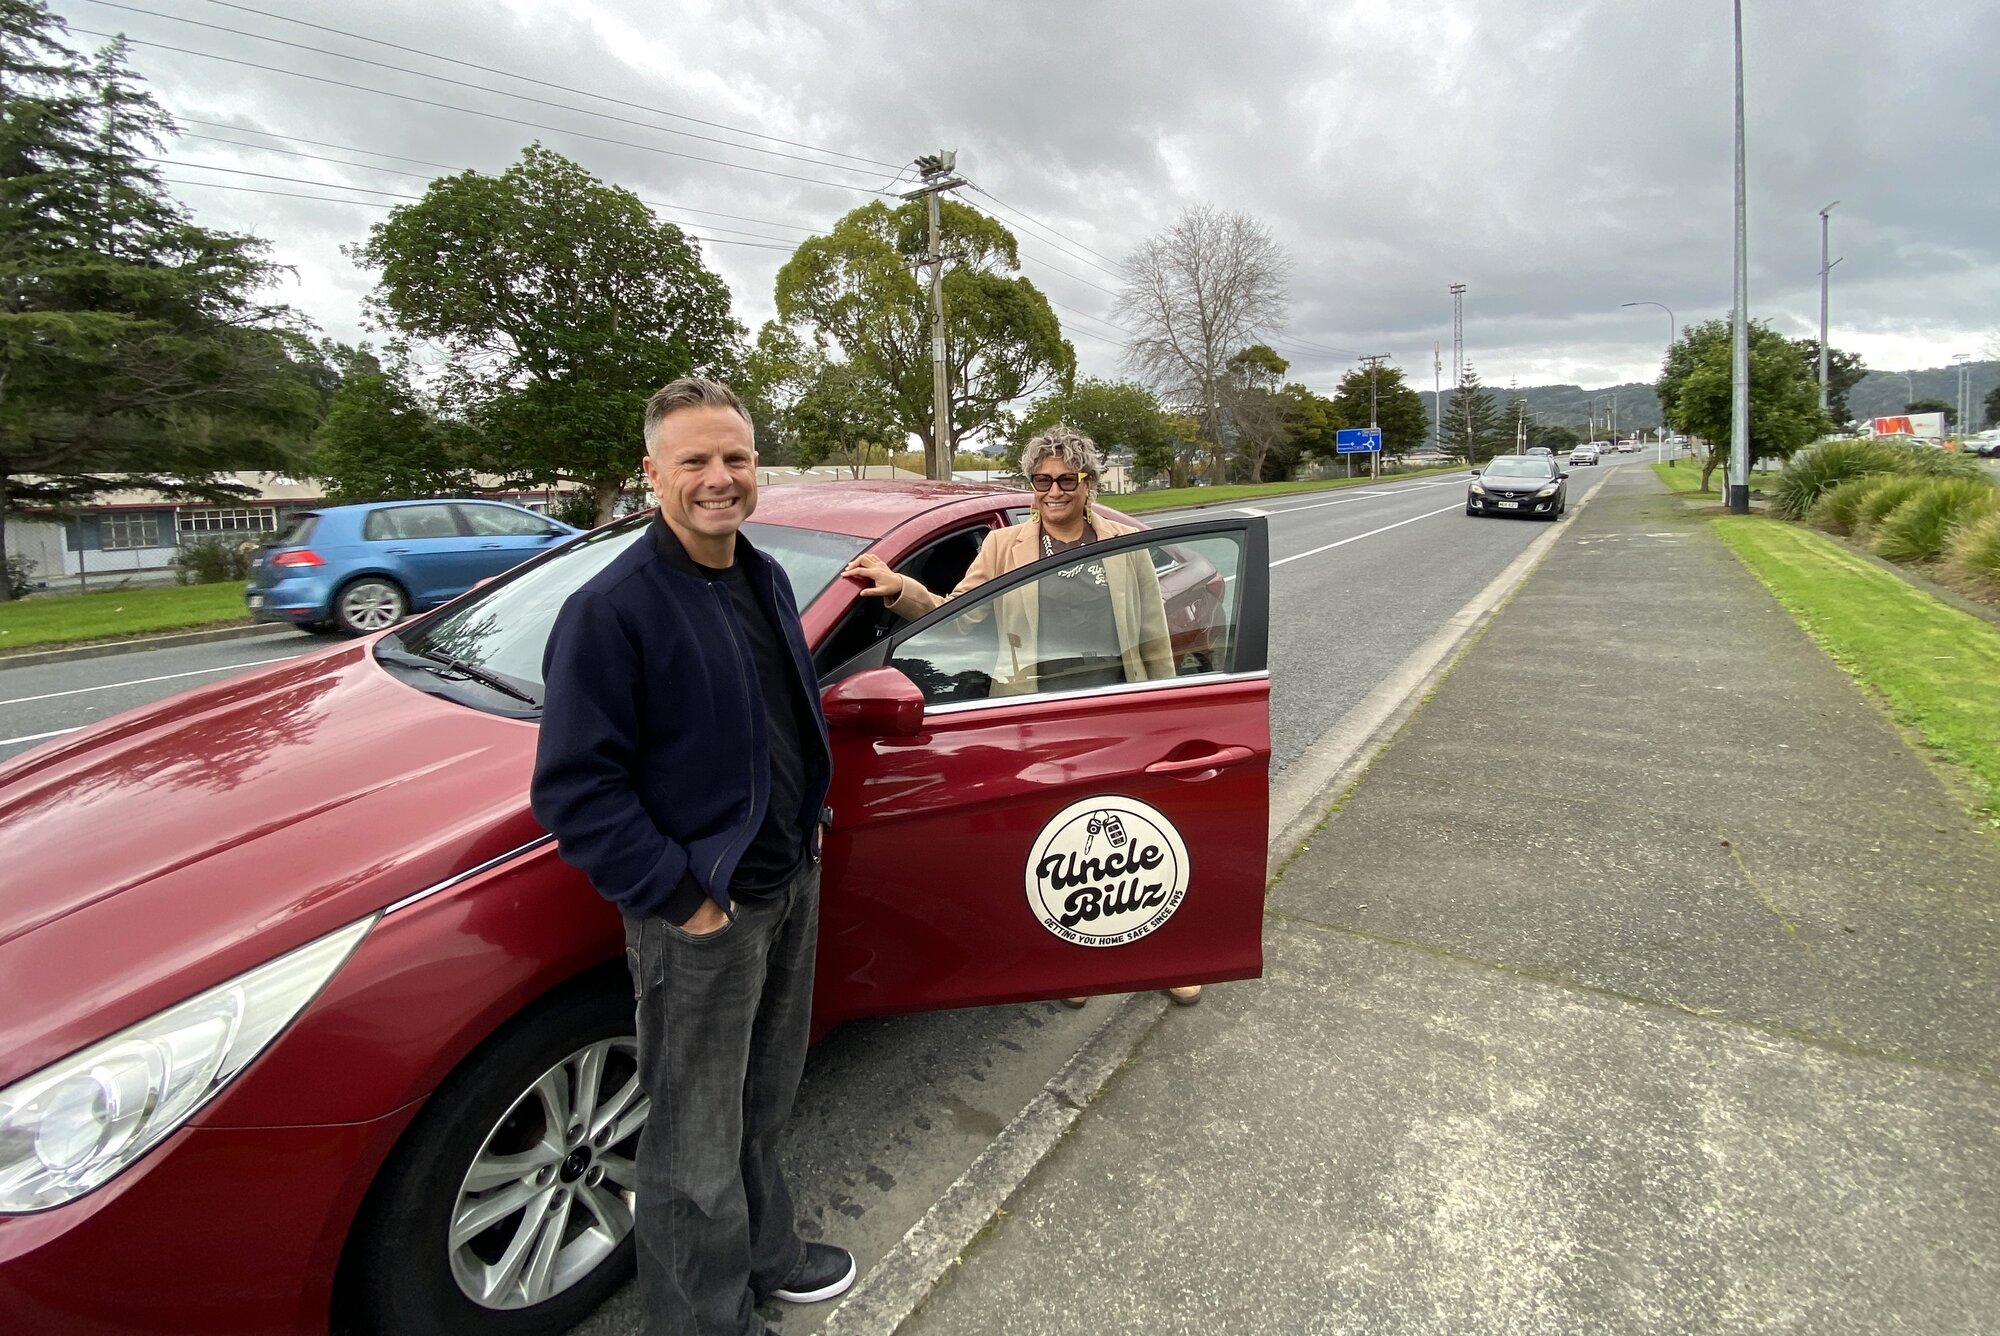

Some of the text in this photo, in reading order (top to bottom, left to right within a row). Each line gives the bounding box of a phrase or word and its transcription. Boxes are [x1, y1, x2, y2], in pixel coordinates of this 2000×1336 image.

[1036, 838, 1164, 890] Uncle
[1044, 890, 1183, 945] GETTING YOU HOME SAFE SINCE 1995
[1060, 877, 1166, 928] Billz
